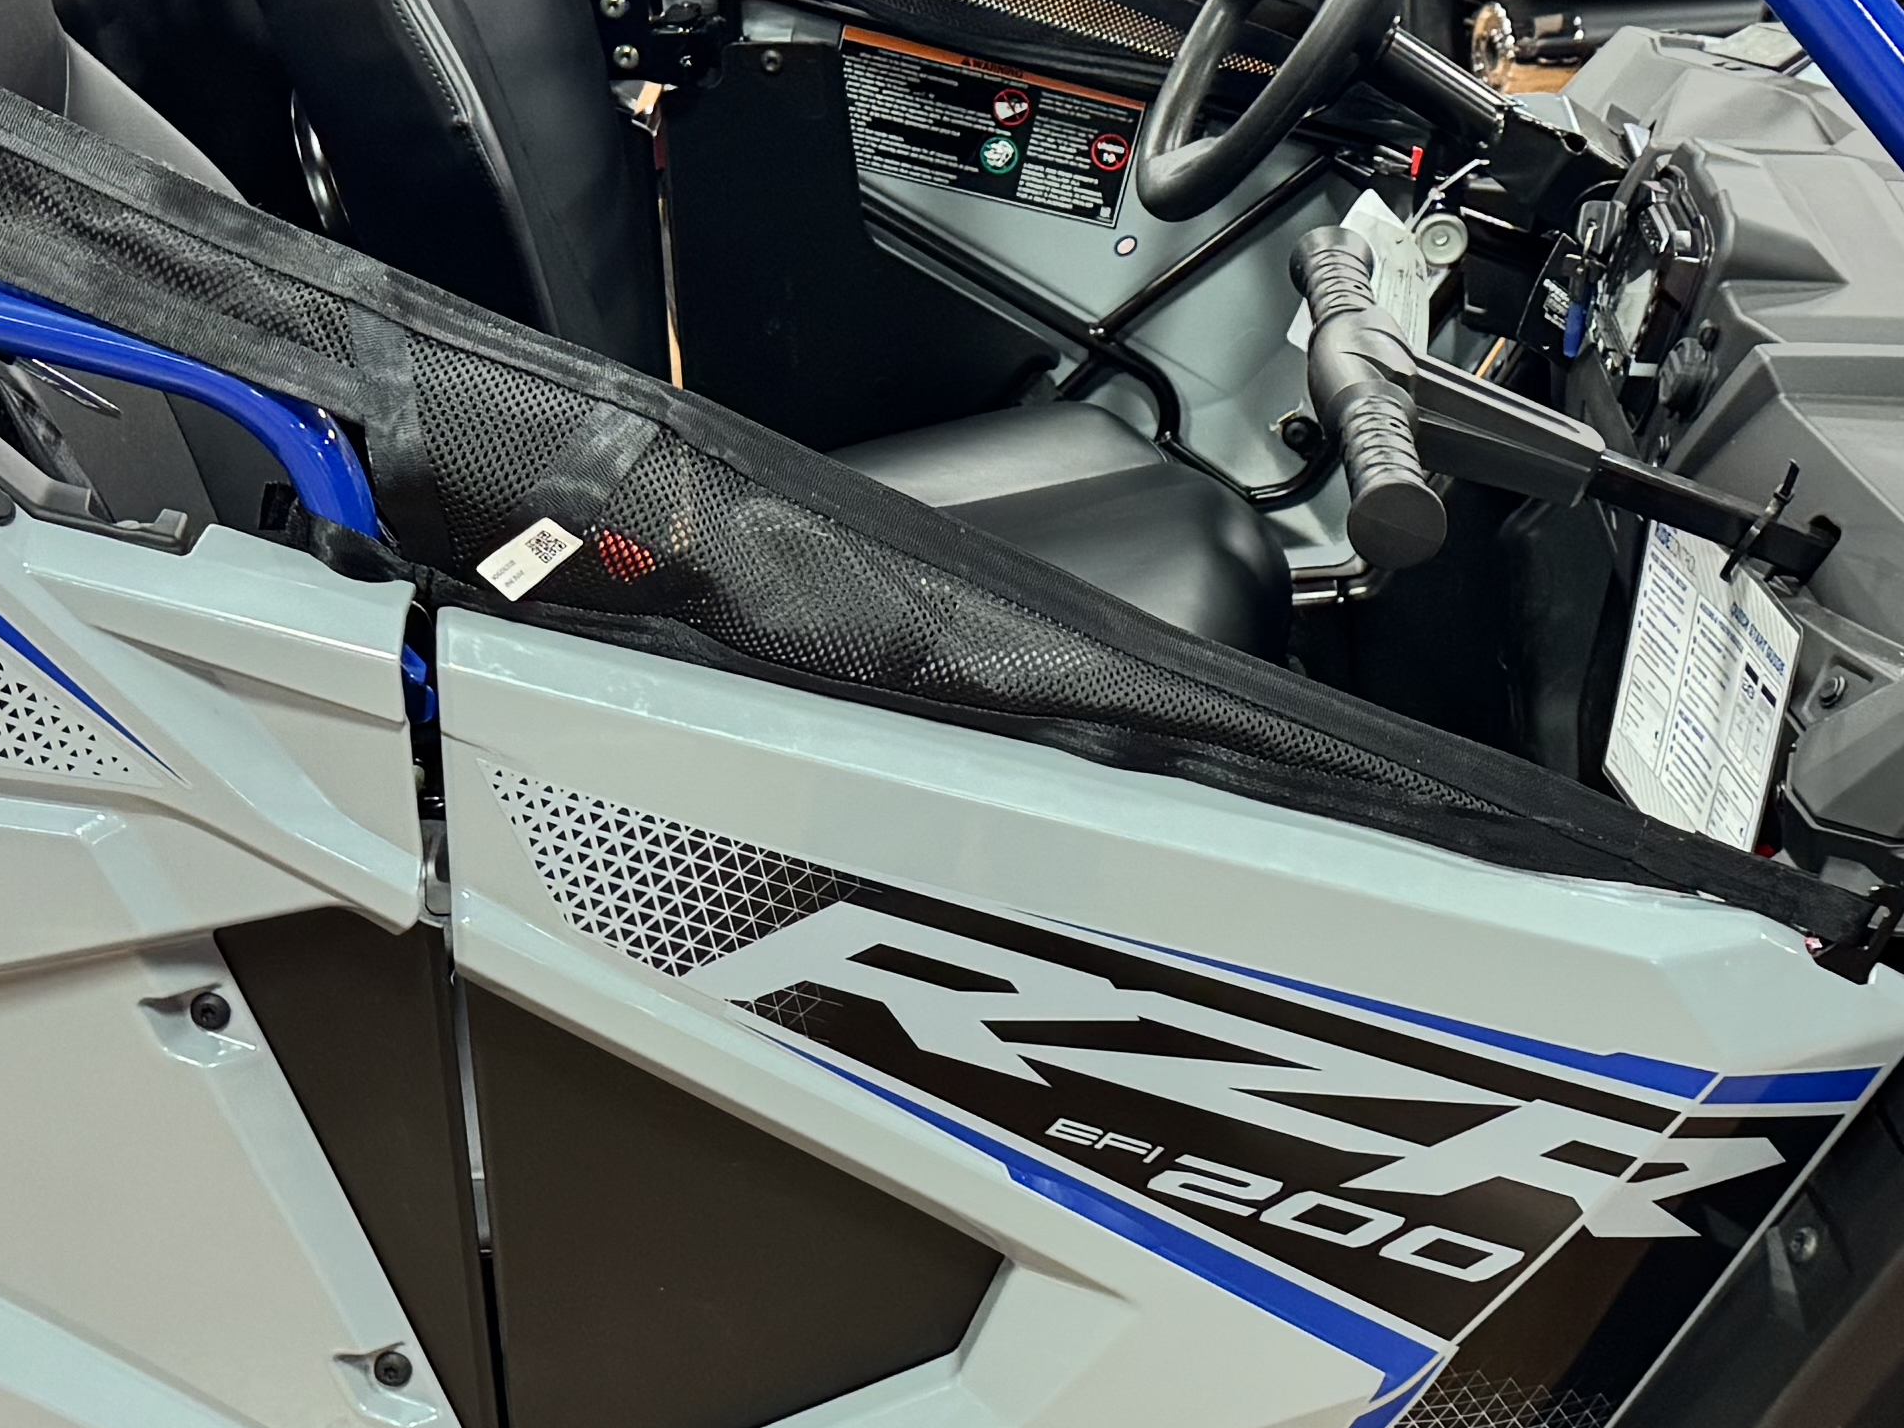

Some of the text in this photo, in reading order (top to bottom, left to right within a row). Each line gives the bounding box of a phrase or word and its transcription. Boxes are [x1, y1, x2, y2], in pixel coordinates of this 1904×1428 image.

[683, 901, 1786, 1239] RZR
[1046, 1117, 1526, 1284] EFI 200
